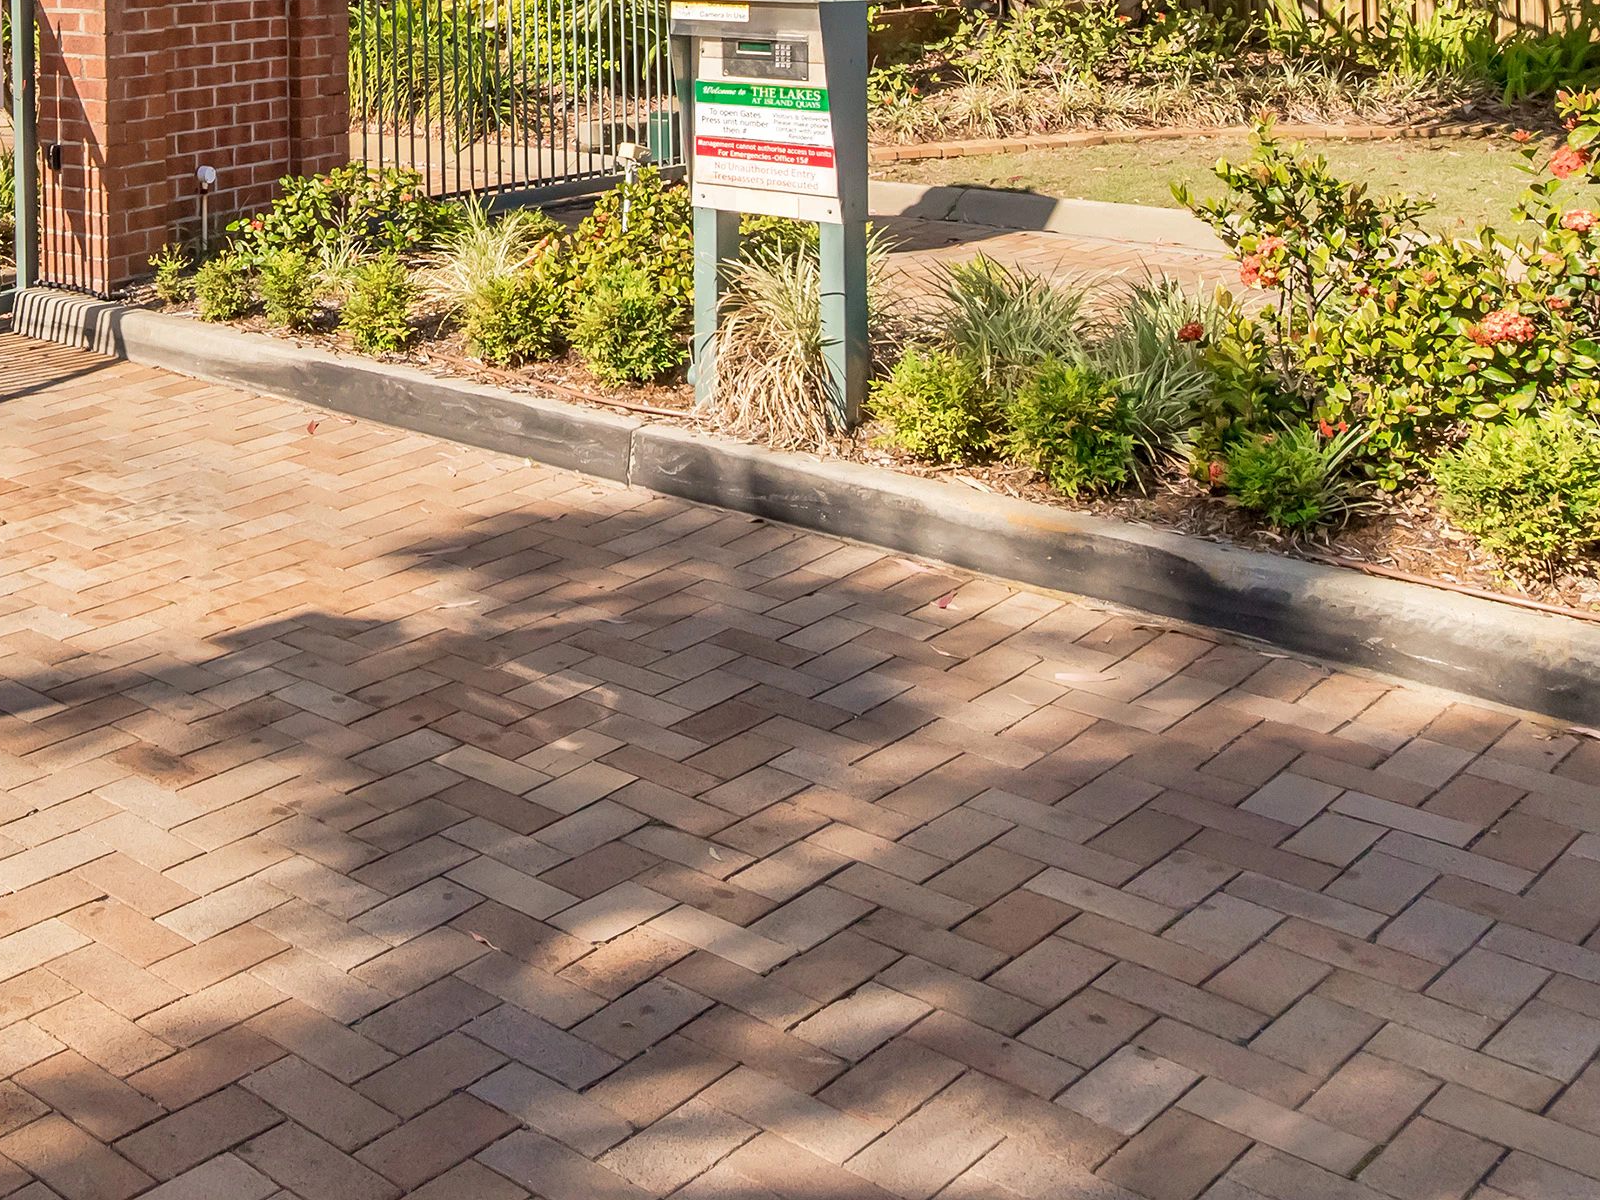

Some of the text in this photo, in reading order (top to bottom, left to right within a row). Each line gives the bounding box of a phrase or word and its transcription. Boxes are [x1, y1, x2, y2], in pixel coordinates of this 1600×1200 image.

[702, 85, 746, 96] Welcome to
[750, 86, 821, 102] THE LAKES
[763, 98, 794, 107] ISLAND
[795, 100, 821, 109] QUAYS
[709, 107, 762, 118] To open Gates
[701, 115, 721, 124] Press
[740, 120, 769, 128] number
[801, 115, 830, 123] Deliveries
[697, 139, 735, 149] Management
[735, 143, 757, 151] cannot
[757, 145, 787, 154] authorise
[787, 148, 808, 156] access
[816, 150, 832, 158] units
[795, 156, 809, 164] 15#
[714, 161, 816, 181] No Unauthorised Entry
[713, 170, 819, 190] Trespassers prosecuted
